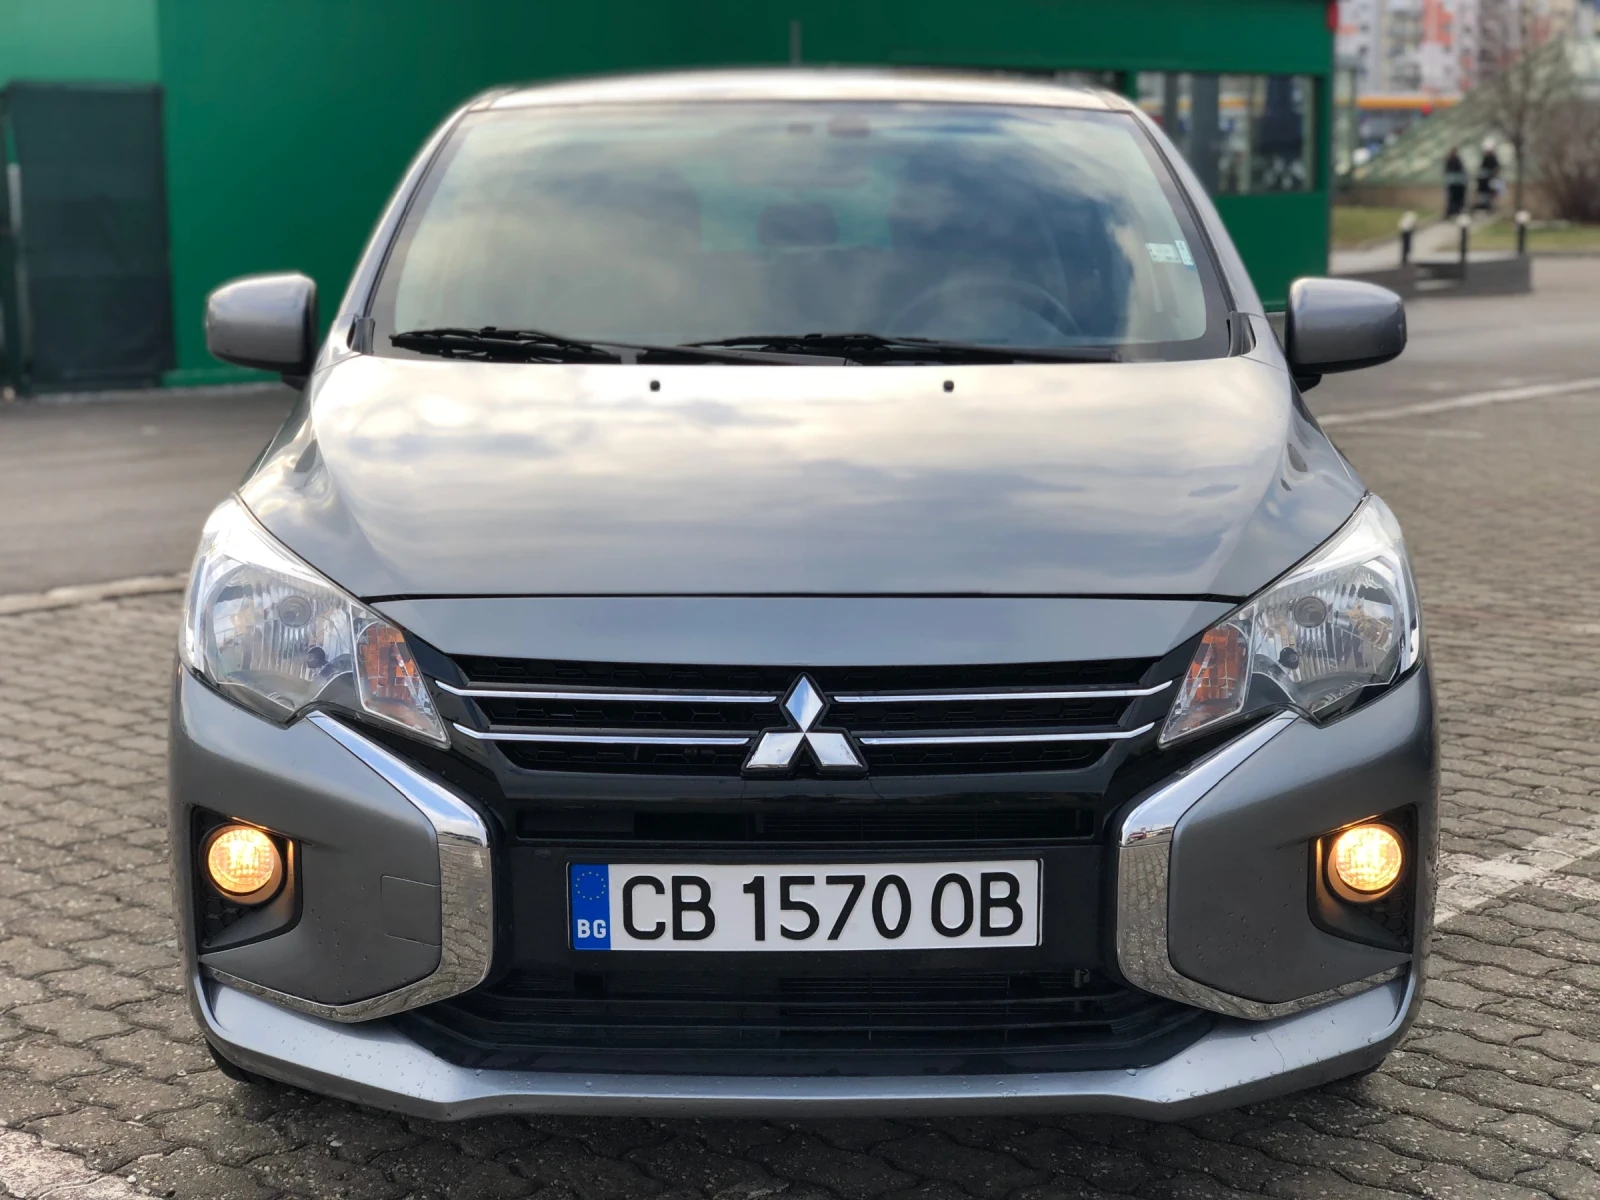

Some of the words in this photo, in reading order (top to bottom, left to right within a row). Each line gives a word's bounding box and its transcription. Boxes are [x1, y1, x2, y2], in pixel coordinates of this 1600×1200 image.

[622, 875, 716, 941] CB
[742, 874, 912, 941] 1570
[930, 871, 1024, 938] OB
[577, 919, 607, 939] BG
